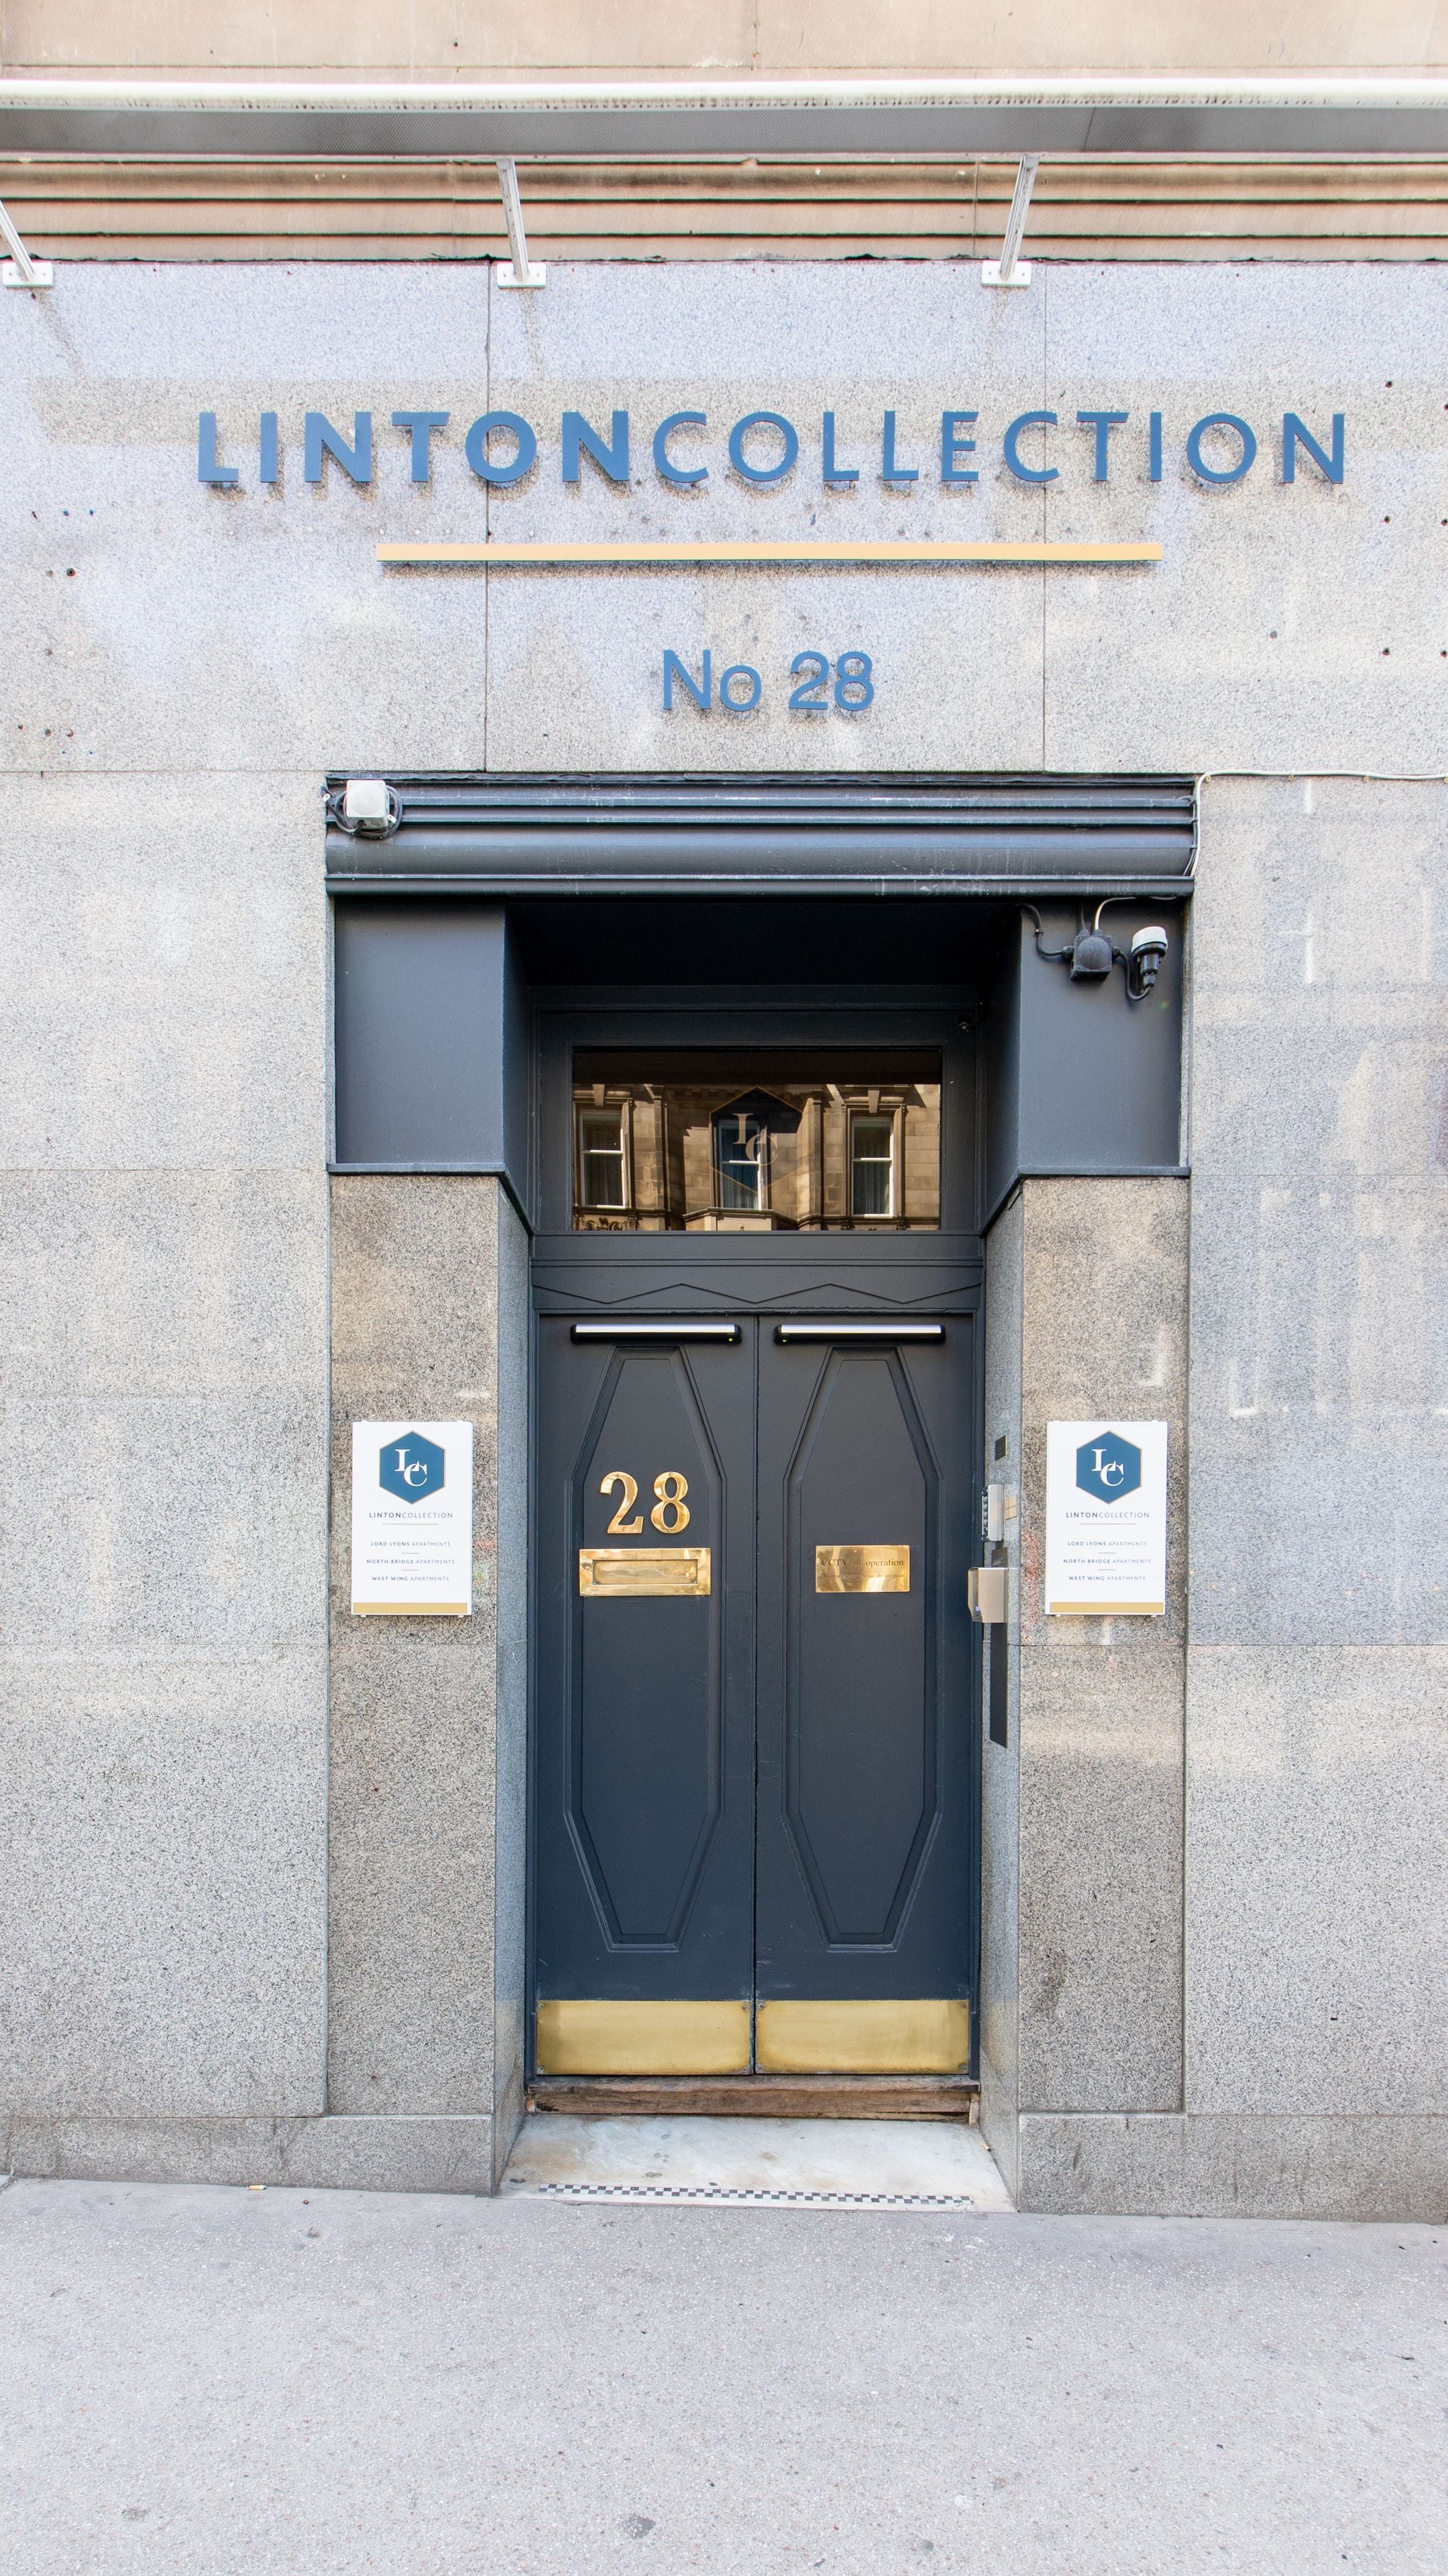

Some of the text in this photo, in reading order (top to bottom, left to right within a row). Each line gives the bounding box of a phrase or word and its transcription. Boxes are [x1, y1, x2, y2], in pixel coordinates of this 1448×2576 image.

[198, 410, 1345, 485] LINTONCOLLECTION
[663, 649, 875, 712] No 28
[600, 1471, 691, 1534] 28
[865, 1558, 904, 1568] operation
